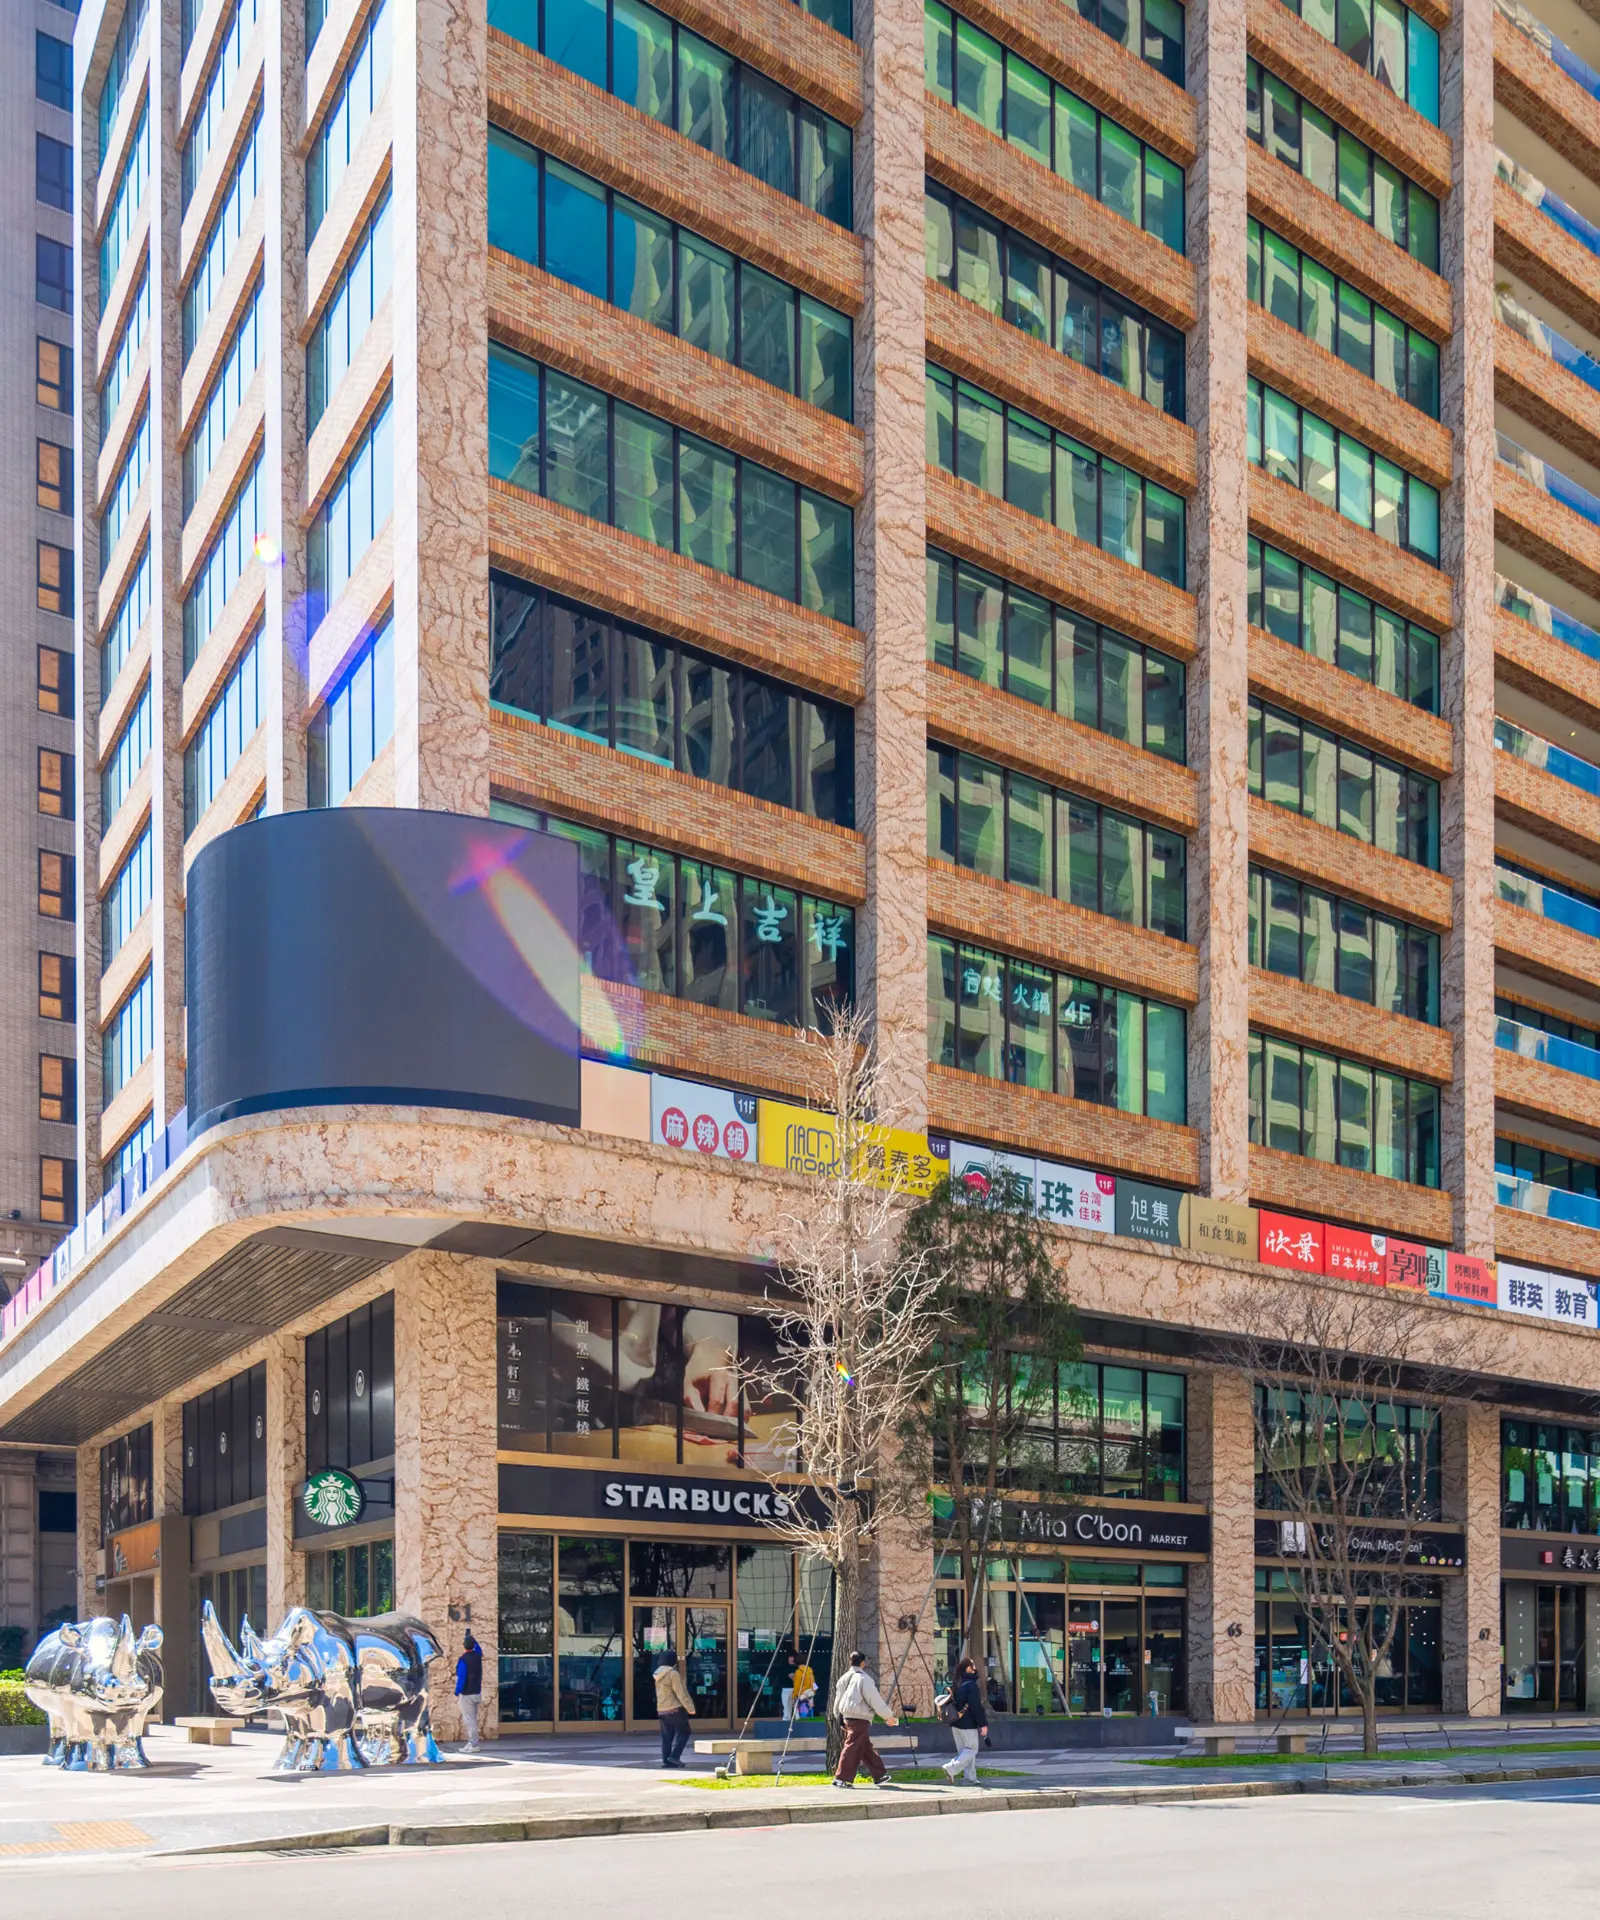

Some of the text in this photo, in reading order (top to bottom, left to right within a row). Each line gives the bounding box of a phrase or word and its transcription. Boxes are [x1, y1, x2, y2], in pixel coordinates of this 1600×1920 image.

[624, 857, 847, 962] 皇上吉祥
[1064, 1001, 1092, 1025] 4F
[738, 1099, 755, 1114] 11F
[665, 1113, 745, 1154] 麻辣鍋
[931, 1143, 946, 1154] 11F
[1098, 1179, 1113, 1191] 11F
[1079, 1189, 1102, 1207] 台灣
[1078, 1207, 1102, 1223] 佳味
[1130, 1195, 1169, 1227] 旭集
[1217, 1214, 1229, 1224] 12F
[1130, 1224, 1170, 1239] SUNRISE
[1199, 1222, 1247, 1246] 和食集錦
[1265, 1229, 1319, 1263] 欣葉
[1331, 1253, 1380, 1275] 日本料理
[1508, 1279, 1588, 1320] 群英教育
[604, 1483, 790, 1517] STARBUCKS
[1020, 1509, 1067, 1538] Mia
[1075, 1513, 1142, 1542] C'bon
[1149, 1534, 1188, 1545] MARKET
[1227, 1622, 1243, 1638] 65
